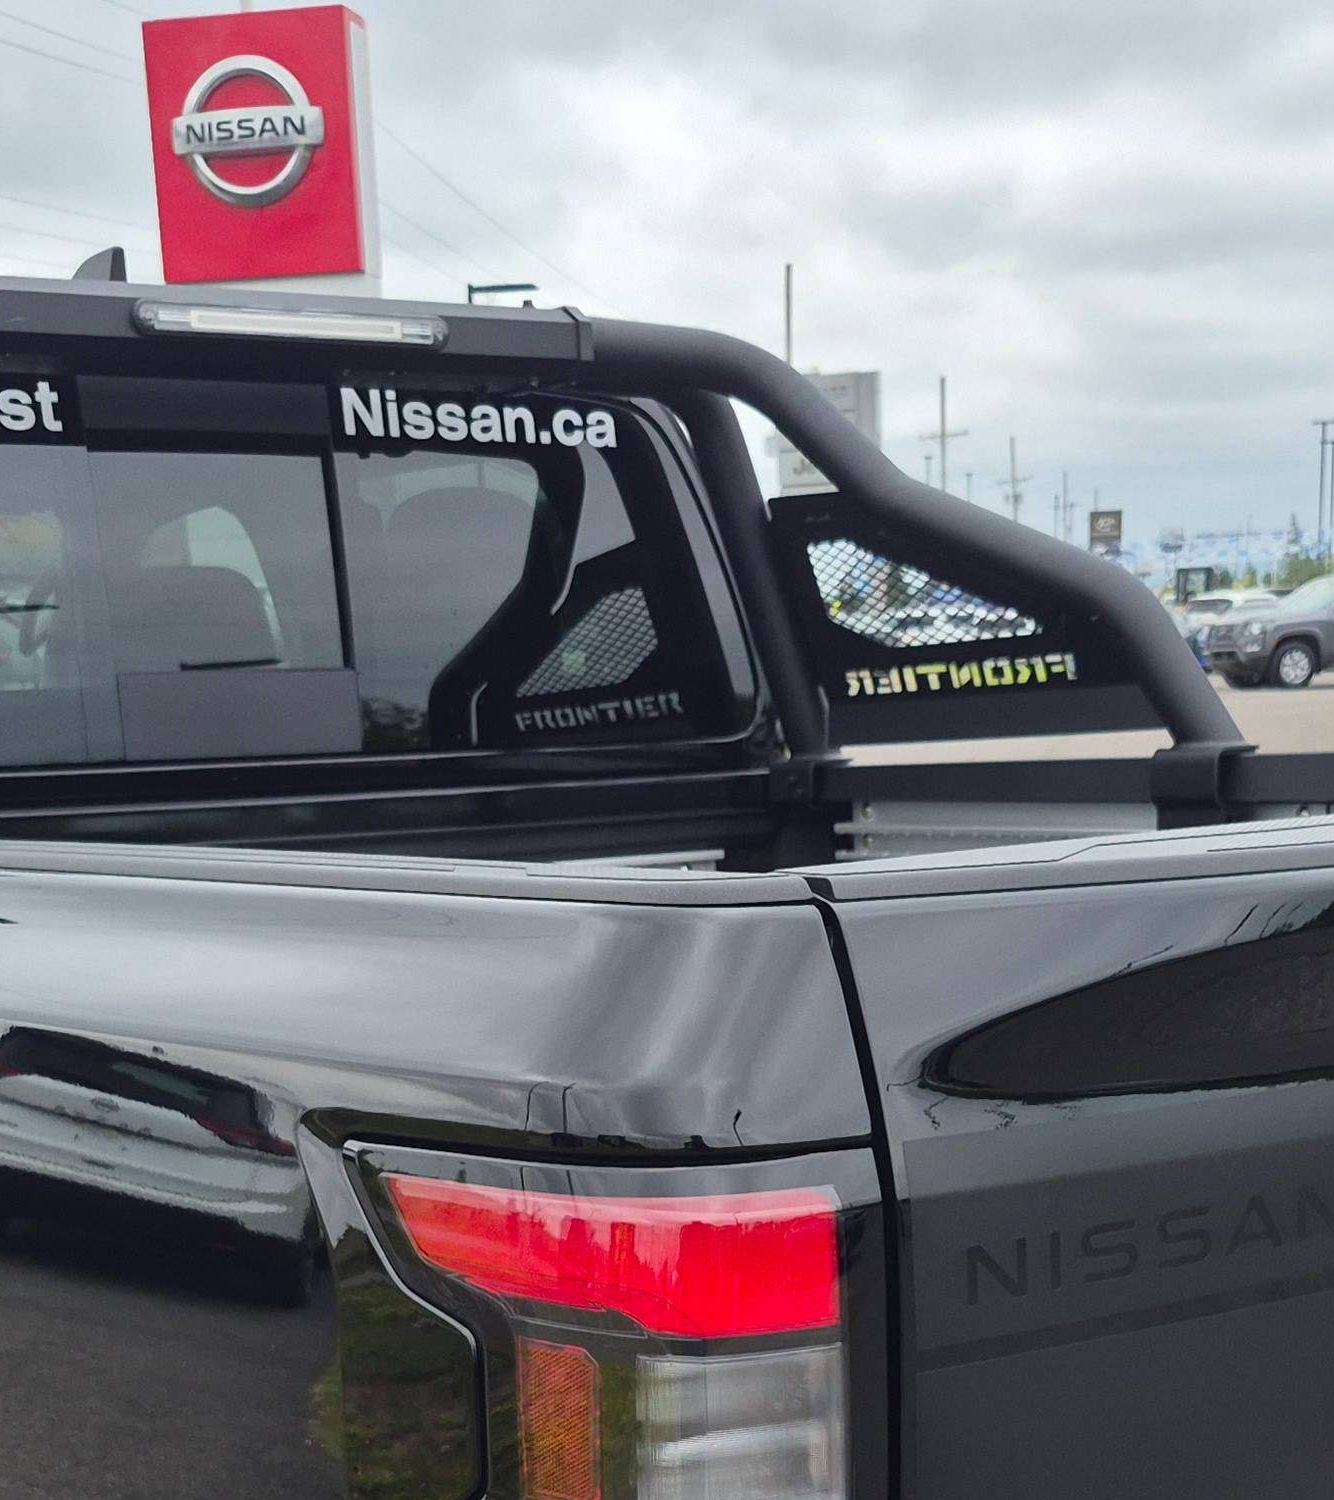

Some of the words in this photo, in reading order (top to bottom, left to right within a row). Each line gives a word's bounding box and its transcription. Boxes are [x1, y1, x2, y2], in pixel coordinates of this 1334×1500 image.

[185, 115, 306, 145] NISSAN
[340, 387, 617, 448] Nissan.ca
[515, 692, 684, 732] FRONTIER
